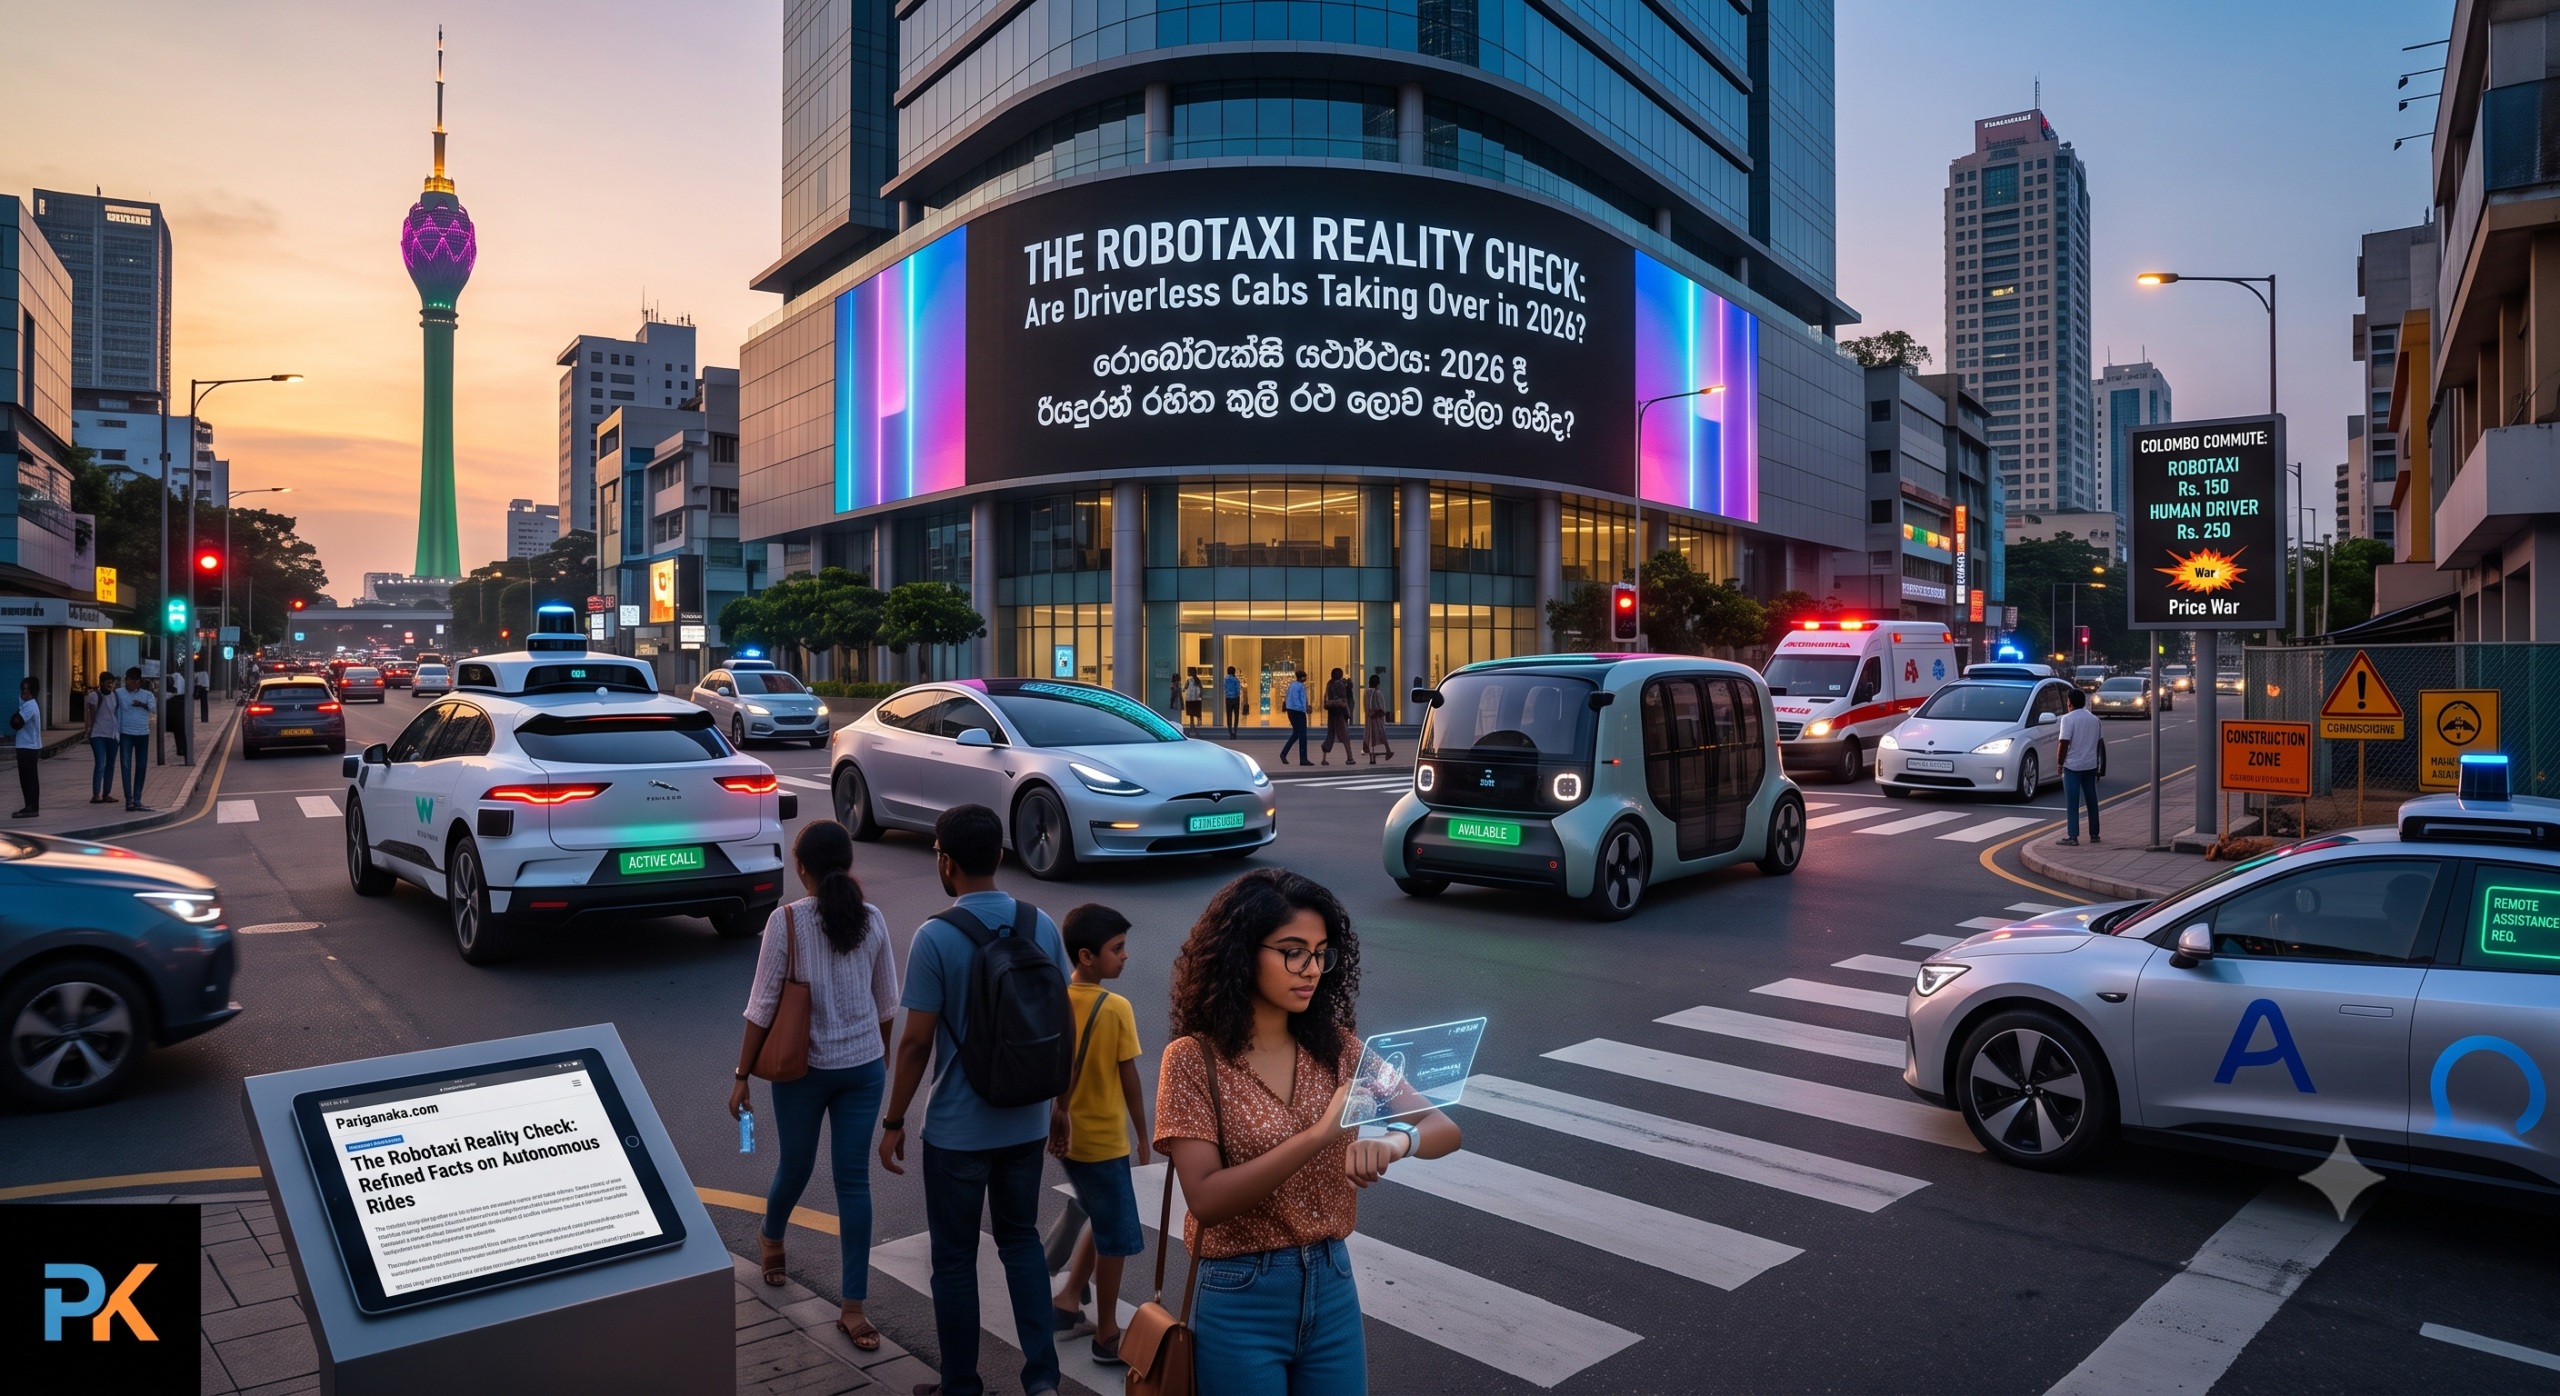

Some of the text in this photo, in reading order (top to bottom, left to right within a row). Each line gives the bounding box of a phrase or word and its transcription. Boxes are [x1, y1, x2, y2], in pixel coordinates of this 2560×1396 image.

[1024, 216, 1586, 303] THE ROBOTAXI REALITY CHECK:
[1024, 273, 1586, 343] Are Driverless Cabs Taking Over in 2026?
[1441, 348, 1504, 384] 2026
[1142, 383, 1216, 416] රහිත
[1290, 382, 1336, 413] රථ
[2141, 431, 2267, 453] COLOMBO COMMUTE:
[2168, 457, 2239, 476] ROBOTAXI
[2179, 479, 2229, 496] Rs. 150
[2150, 499, 2258, 519] HUMAN DRIVER
[2177, 522, 2230, 539] Rs. 250
[2195, 567, 2215, 578] War
[2169, 599, 2240, 615] Price War
[2226, 729, 2305, 746] CONSTRUCTION
[2248, 751, 2281, 767] ZONE
[1458, 823, 1507, 839] AVAILABLE
[628, 852, 697, 869] ACTIVE CALL
[2494, 897, 2539, 912] REMOTE
[2492, 913, 2560, 929] ASSISTANCE
[335, 1103, 439, 1129] Pariganaka.com
[351, 1154, 385, 1172] The
[388, 1137, 462, 1166] Robotaxi
[463, 1129, 520, 1156] Reality
[522, 1118, 578, 1140] Check:
[358, 1134, 601, 1193] Refined Facts on Autonomous
[365, 1194, 416, 1215] Rides
